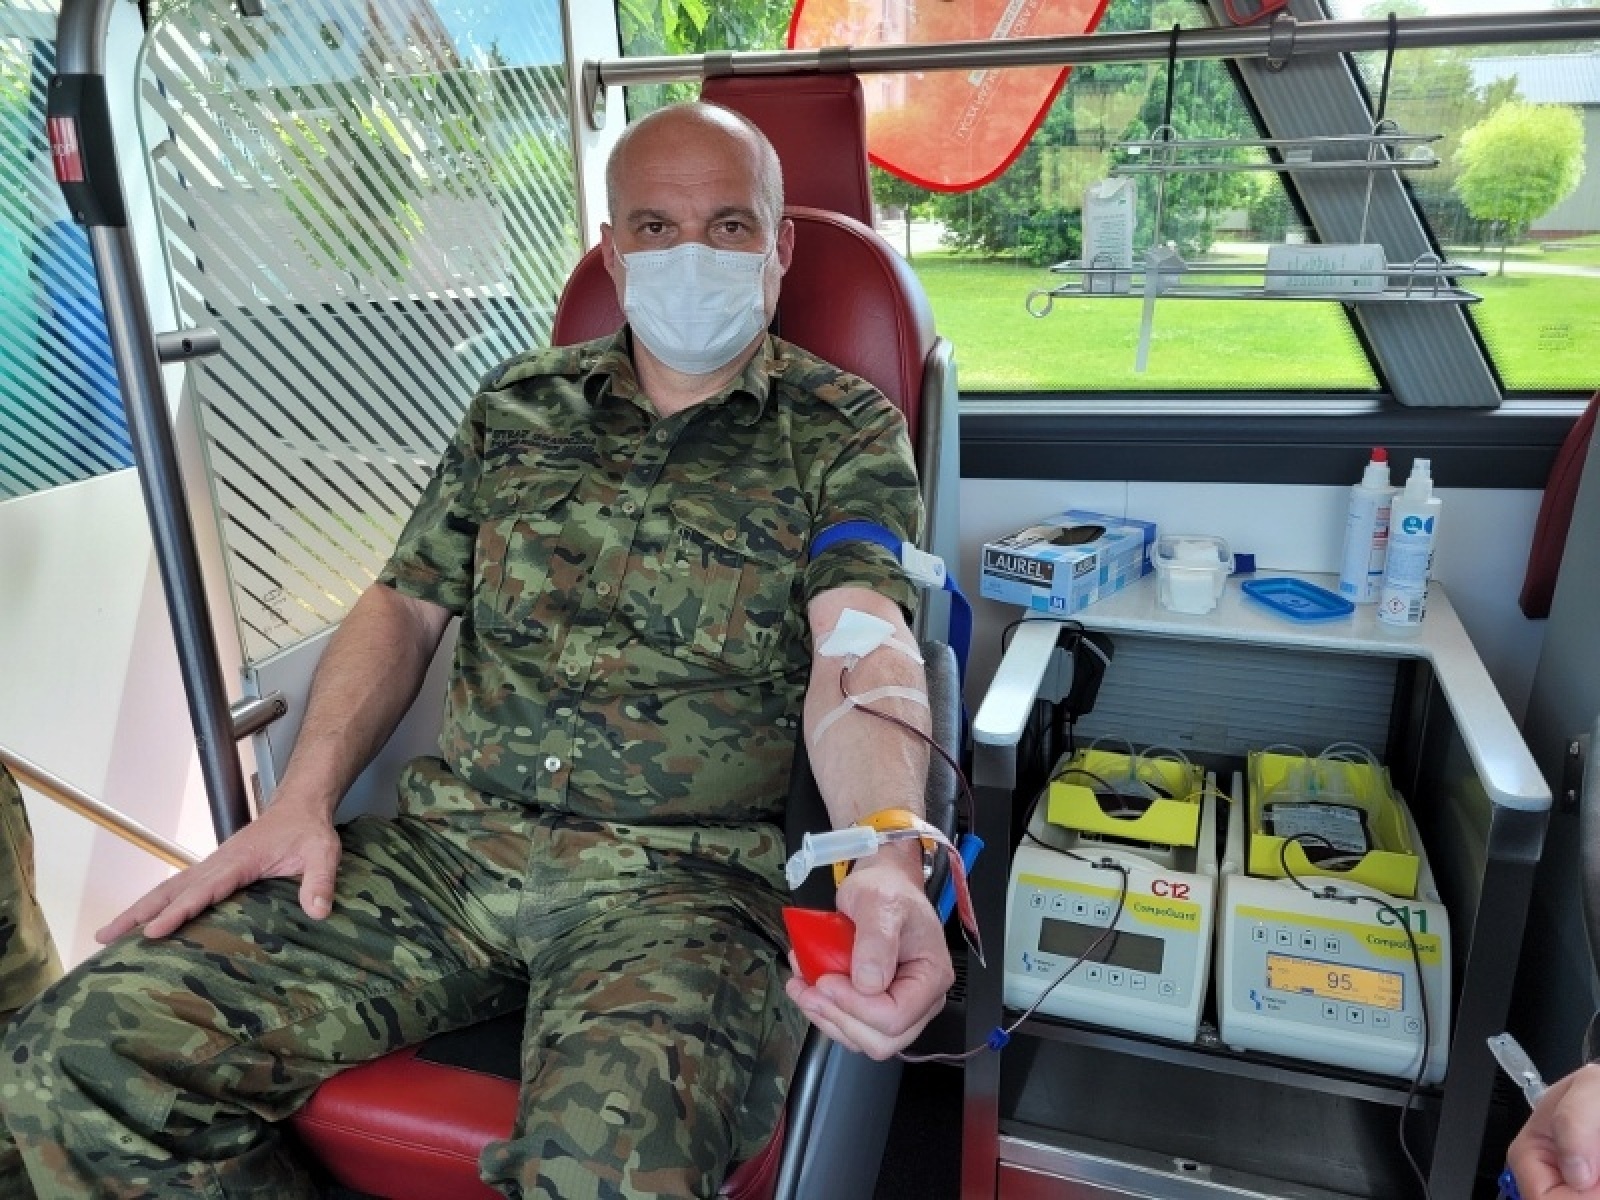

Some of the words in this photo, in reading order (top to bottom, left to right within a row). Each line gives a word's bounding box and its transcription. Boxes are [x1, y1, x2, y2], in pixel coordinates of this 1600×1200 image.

[986, 551, 1045, 580] LAUREL
[1151, 879, 1191, 900] C12
[1133, 902, 1197, 921] CompoGuard
[1375, 906, 1428, 934] C11
[1366, 934, 1437, 953] CompoGard
[1327, 971, 1353, 990] 95
